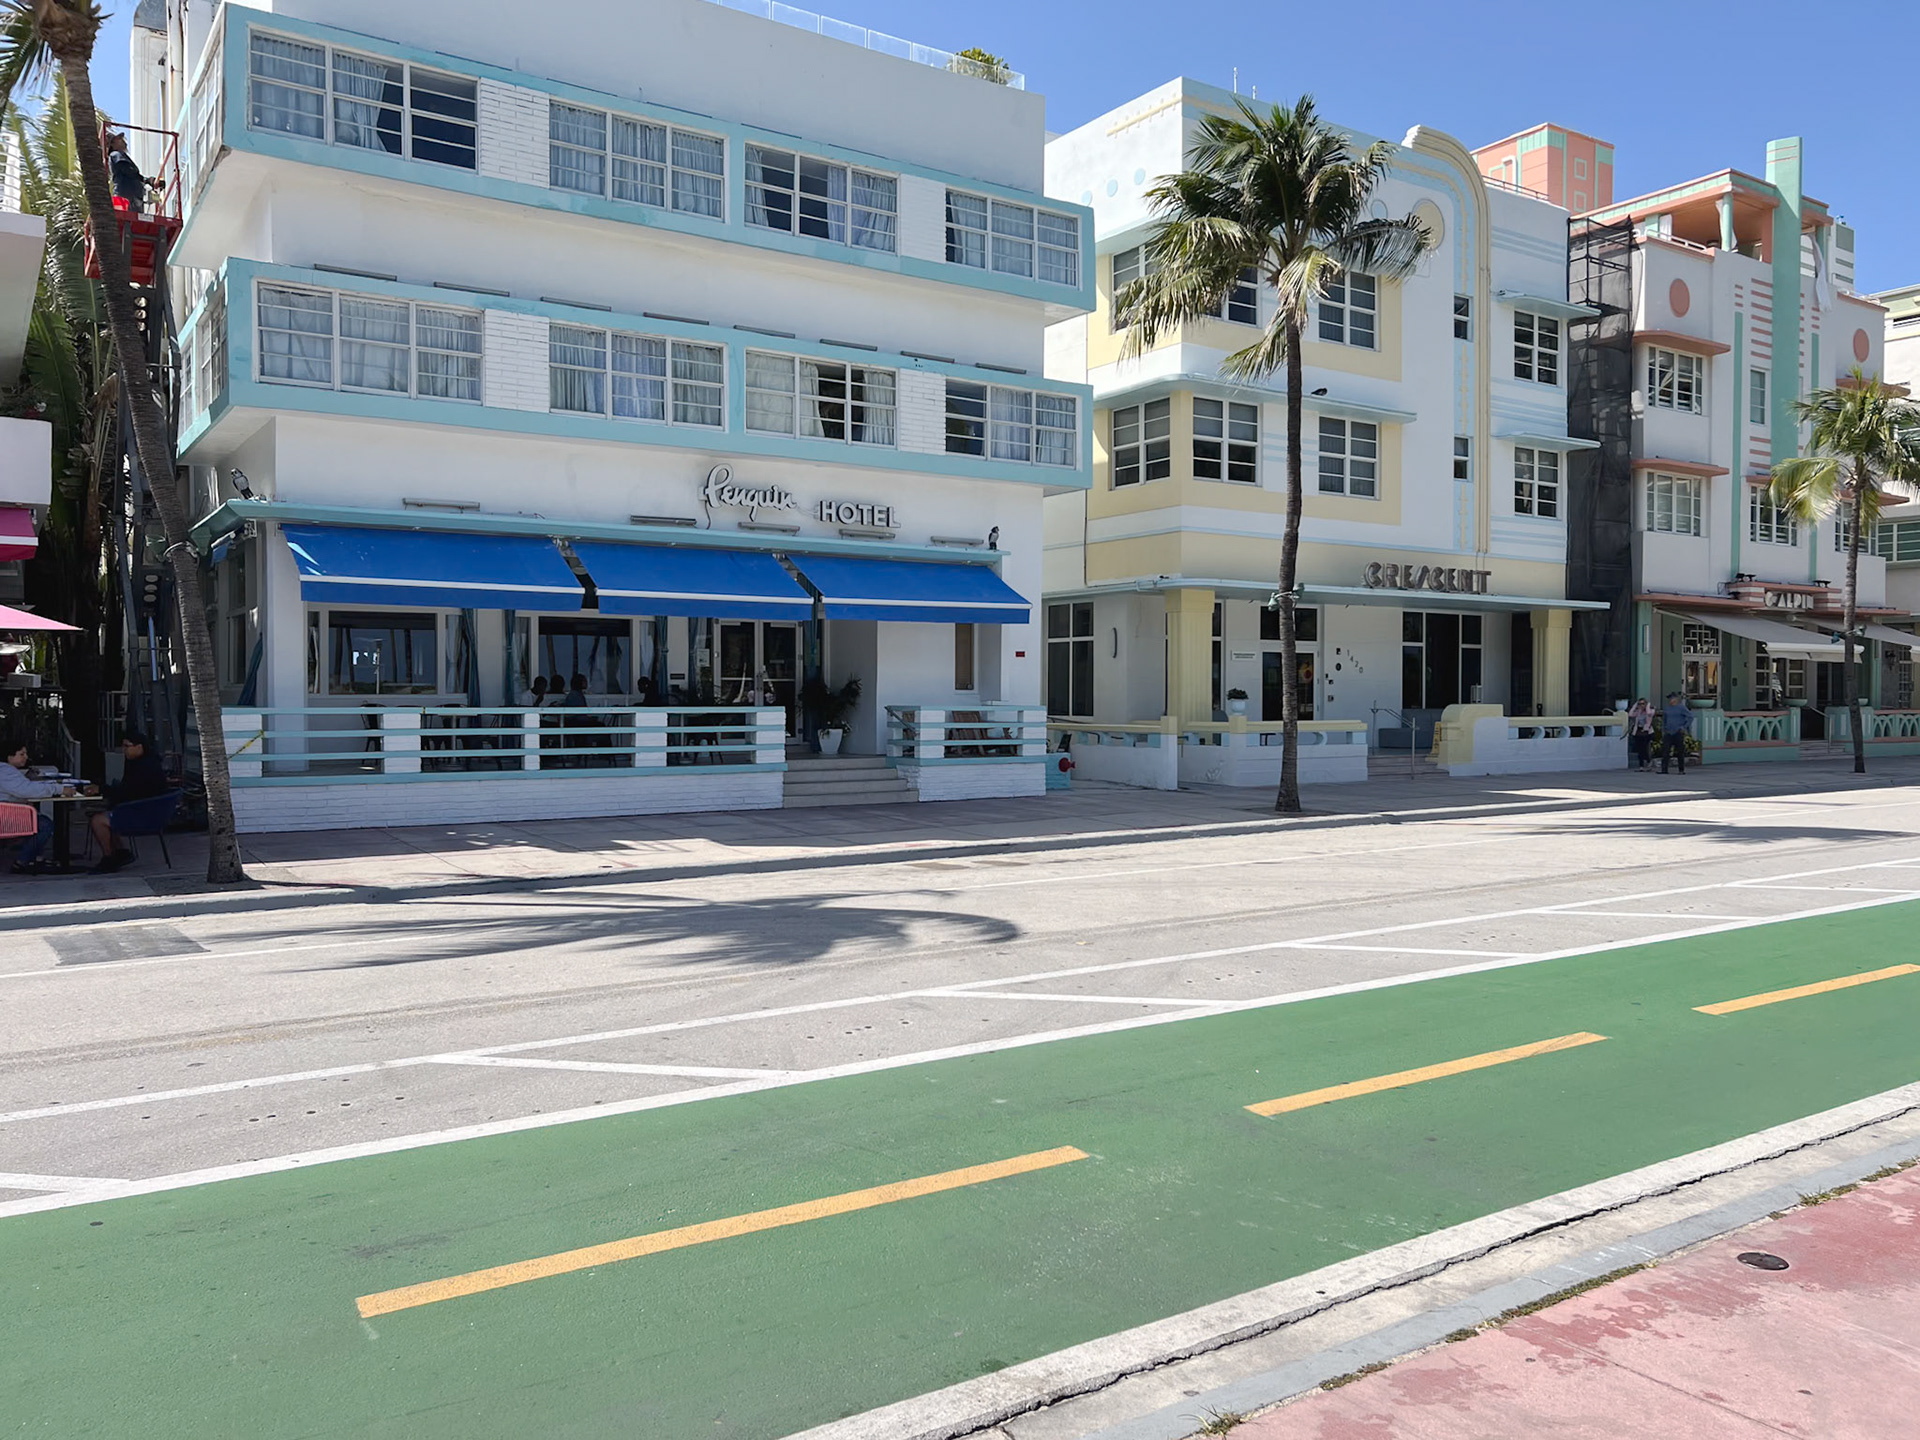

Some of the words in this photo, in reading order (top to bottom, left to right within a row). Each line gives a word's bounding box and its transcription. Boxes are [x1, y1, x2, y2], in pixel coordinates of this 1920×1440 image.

[704, 464, 797, 521] Penguin
[820, 500, 900, 528] HOTEL
[1365, 562, 1491, 593] CRESCENT
